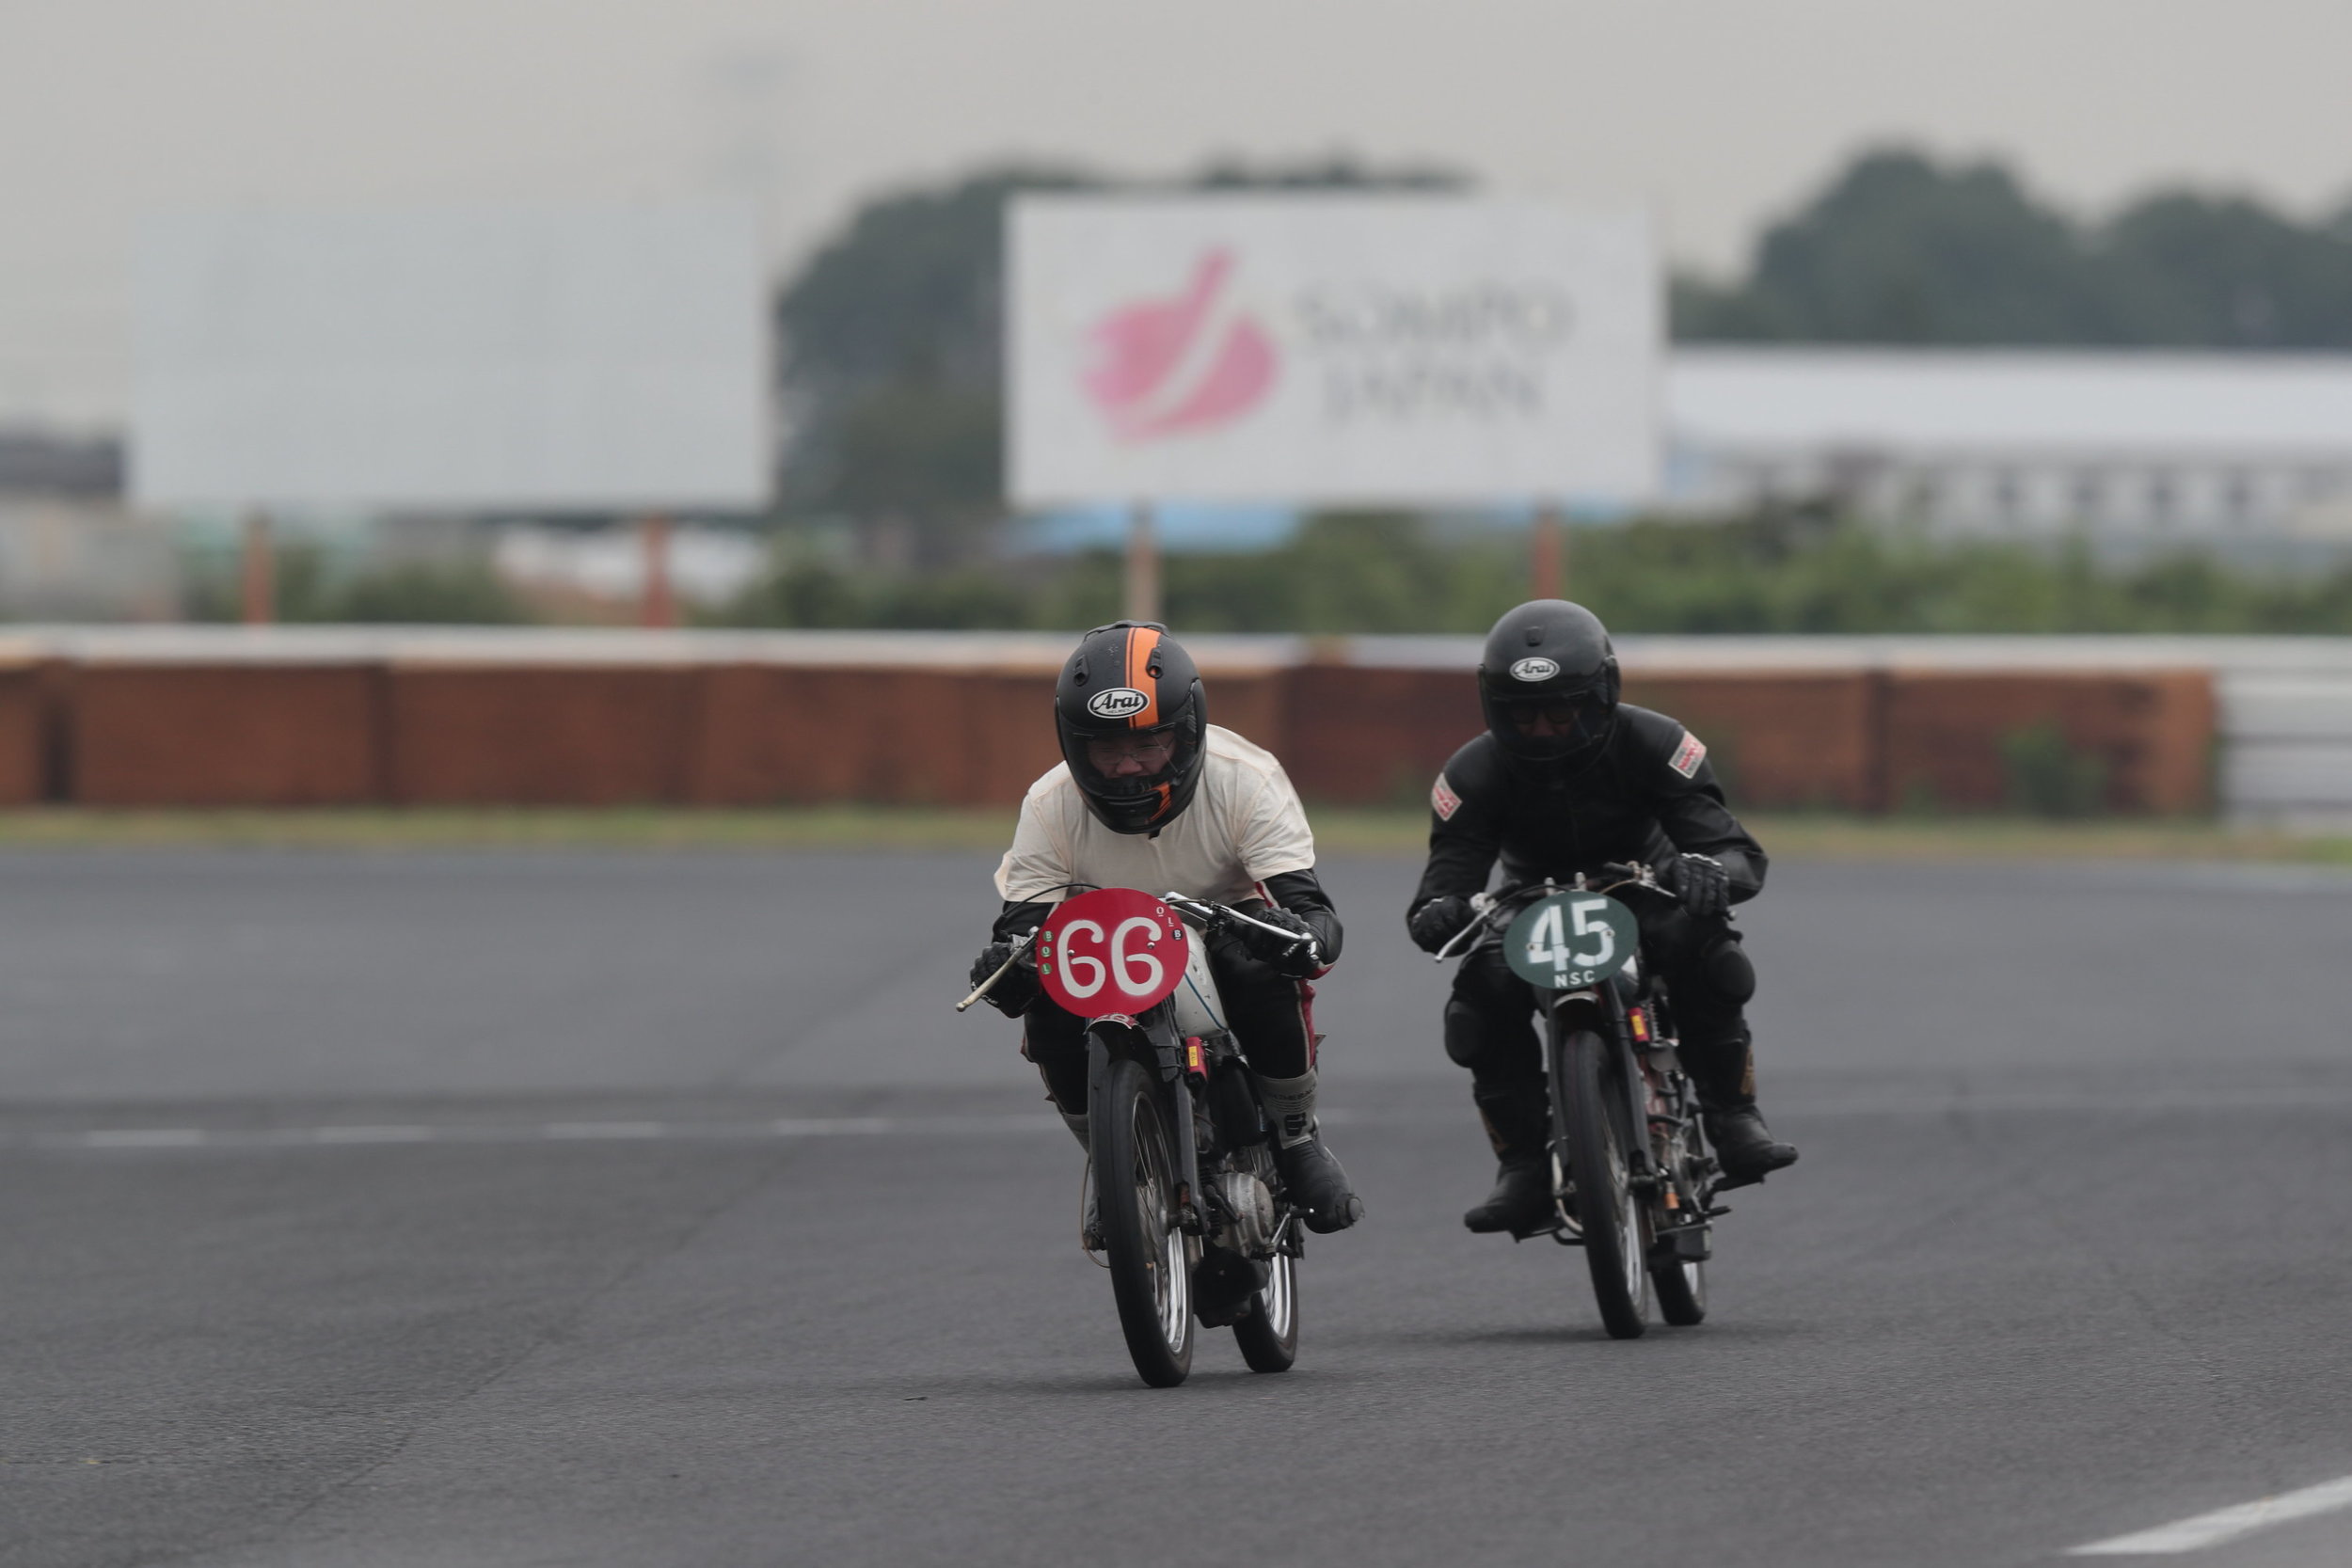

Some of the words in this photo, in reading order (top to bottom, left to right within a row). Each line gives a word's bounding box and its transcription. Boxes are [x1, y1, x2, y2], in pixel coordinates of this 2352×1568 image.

[1093, 692, 1141, 710] Arai
[1057, 916, 1164, 999] 66
[1528, 898, 1614, 972] 45
[1554, 970, 1595, 989] NSC
